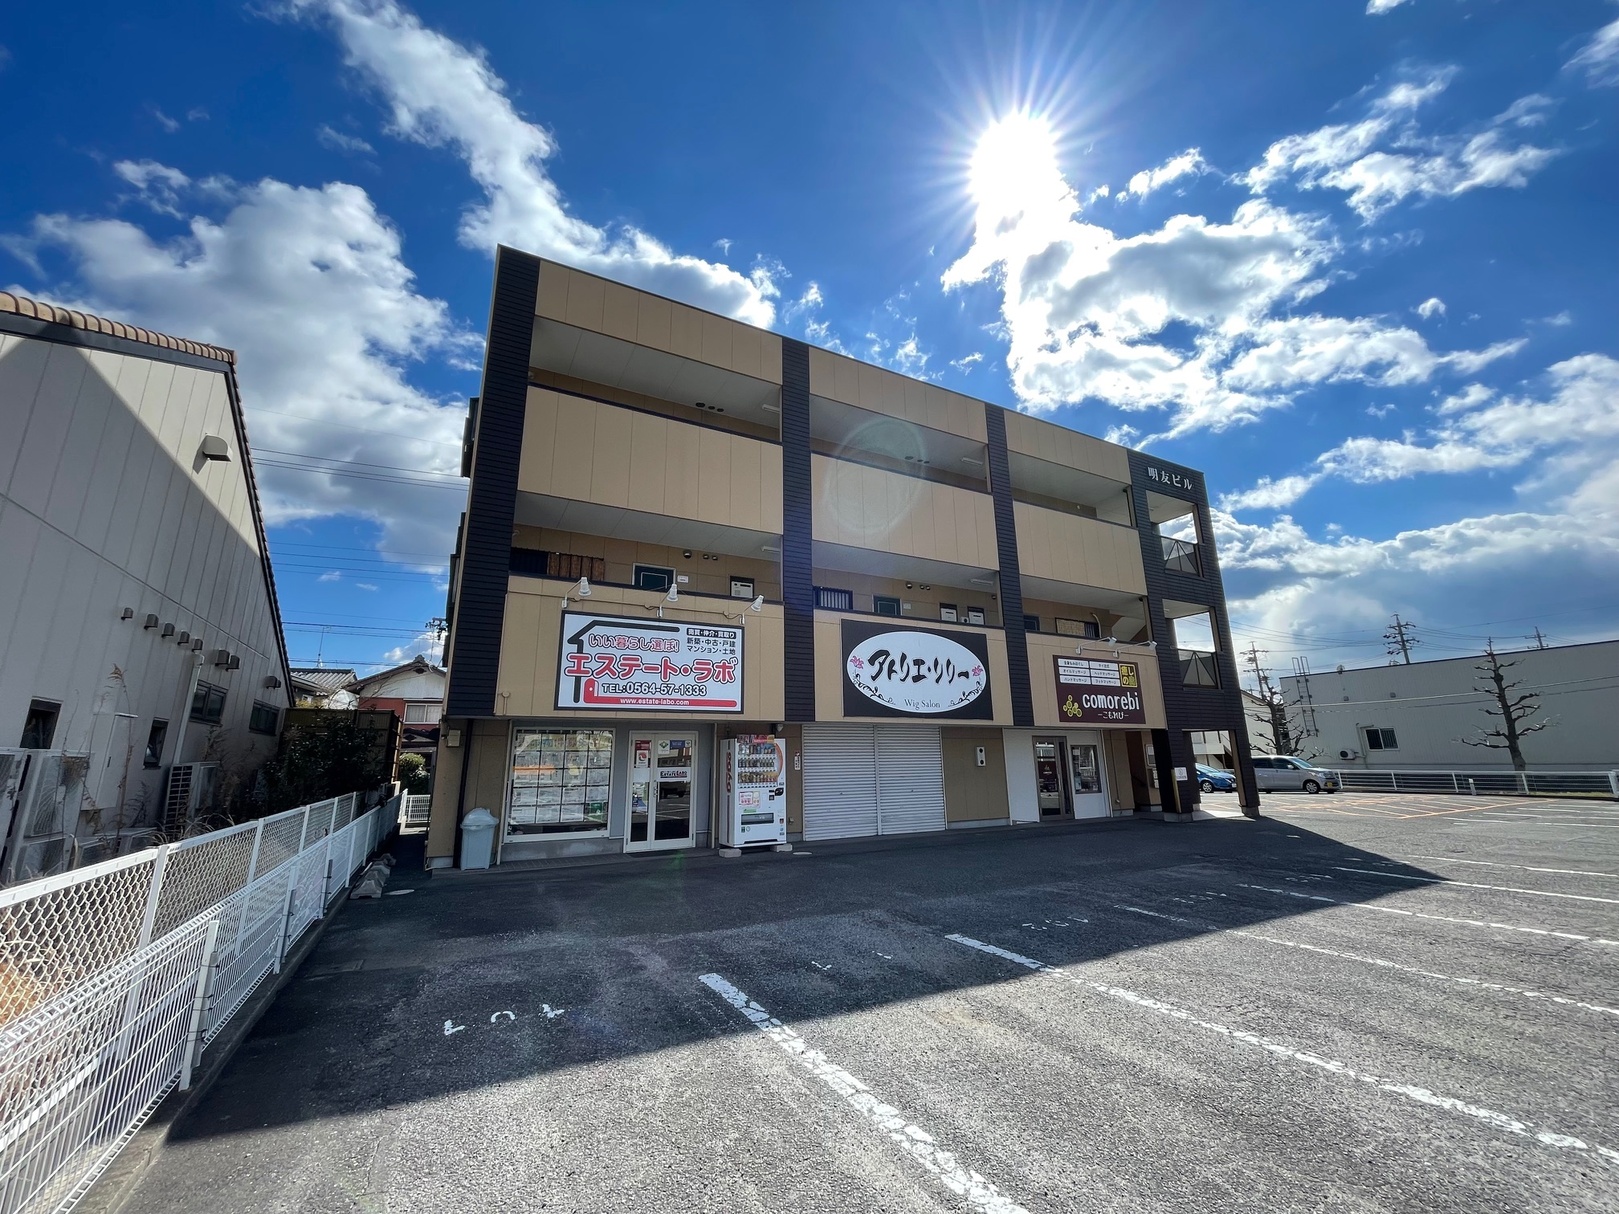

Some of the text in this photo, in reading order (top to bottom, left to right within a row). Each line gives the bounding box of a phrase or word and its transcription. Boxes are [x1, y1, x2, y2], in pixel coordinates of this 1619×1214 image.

[1147, 466, 1193, 490] 明友ビル
[686, 645, 736, 655] マンション・土地
[564, 652, 738, 683] エステート・ラボ
[620, 698, 690, 706] www.estate-labo.com
[904, 699, 941, 710] Wig Salon
[1082, 691, 1140, 710] comorebi
